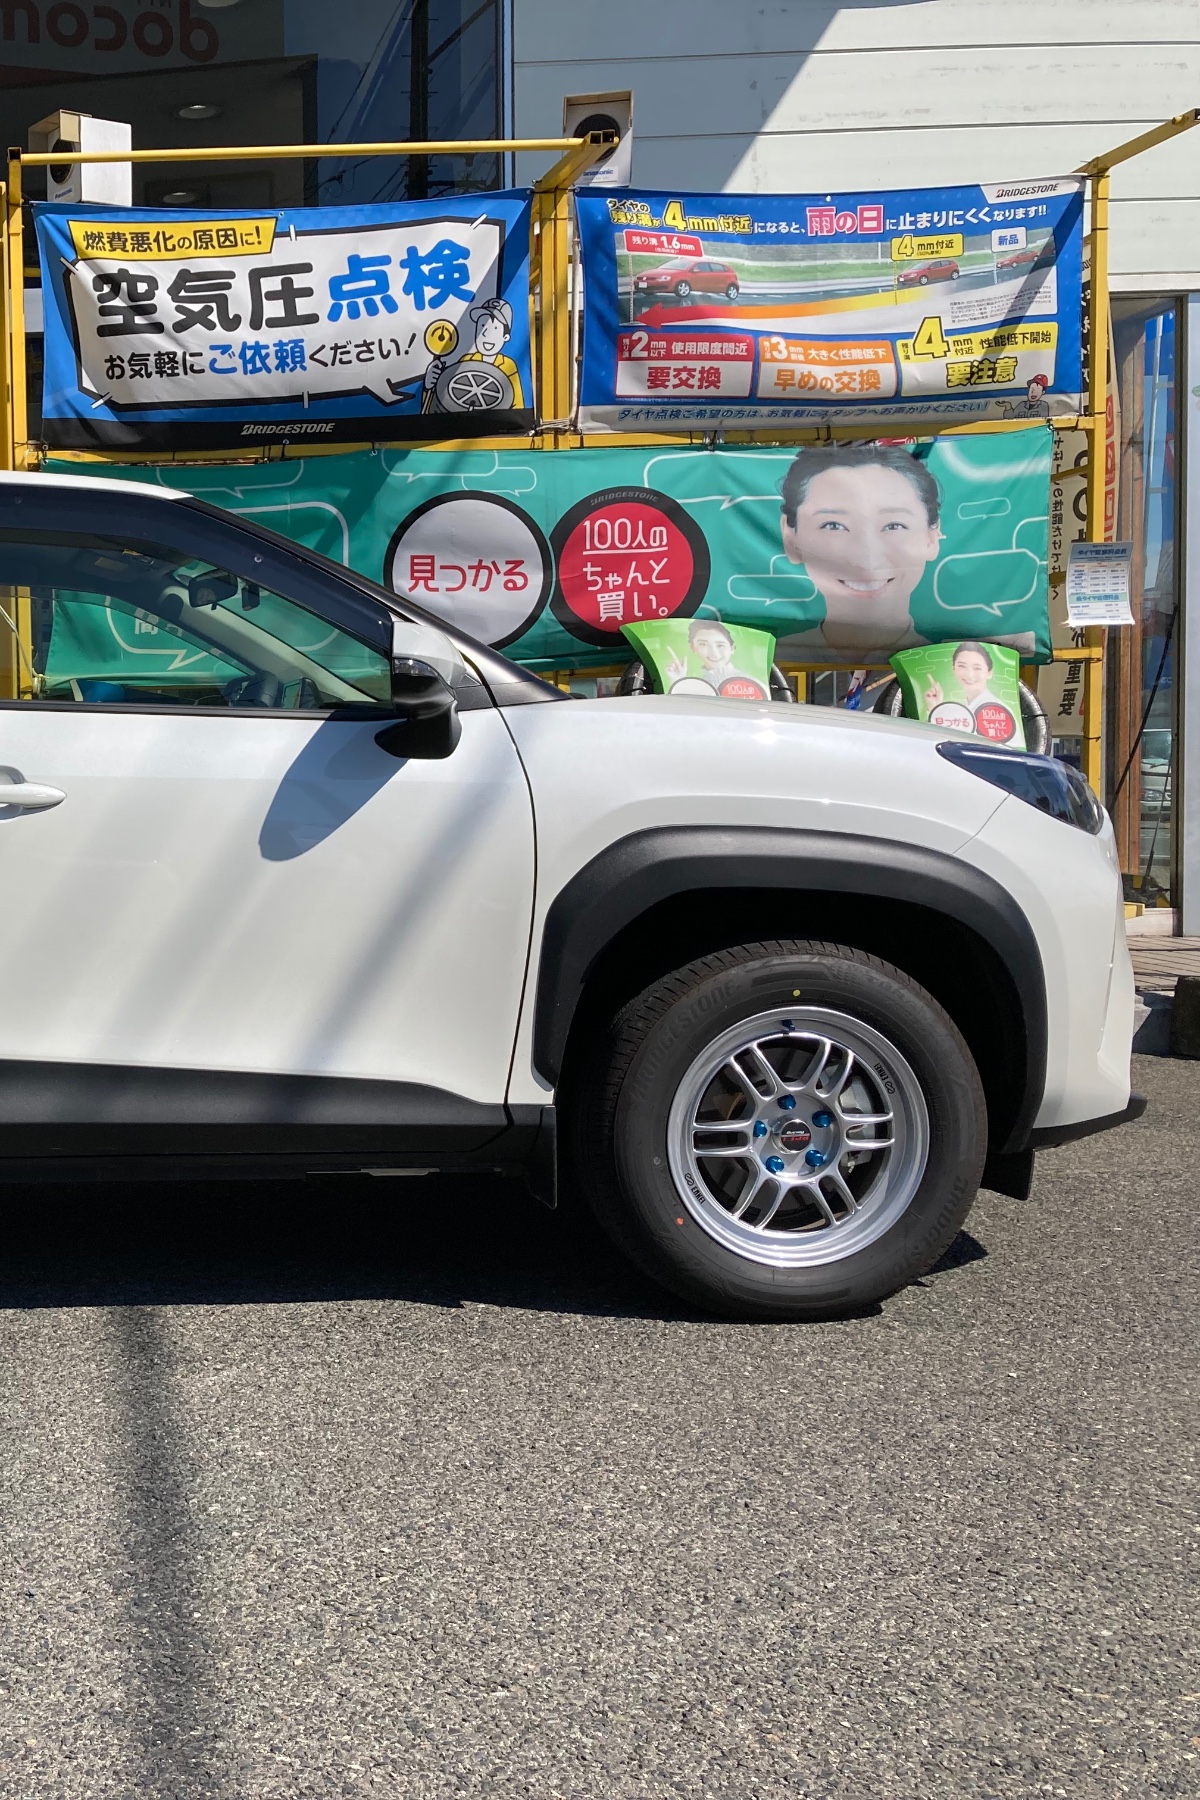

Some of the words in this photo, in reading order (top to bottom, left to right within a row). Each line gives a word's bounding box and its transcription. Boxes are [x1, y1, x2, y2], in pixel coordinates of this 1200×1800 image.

[996, 182, 1060, 199] BRIDGESTONE
[81, 225, 263, 255] 燃費悪化の原因に!
[997, 233, 1020, 247] 新品
[95, 239, 476, 338] 空気圧点検
[631, 331, 650, 358] 2
[770, 335, 788, 360] 3
[979, 330, 1052, 350] 性能低下開始
[104, 333, 417, 381] お気軽にご依頼ください!
[646, 366, 722, 390] 要交換
[773, 368, 882, 393] 早めの交換
[946, 356, 1018, 388] 要注意
[240, 422, 336, 436] BRIDGESTONE
[589, 490, 660, 506] BRIDGESTONE
[582, 517, 669, 550] 100人の
[408, 554, 530, 593] 見つかる
[583, 557, 671, 592] ちゃんと
[596, 591, 669, 622] 買い。
